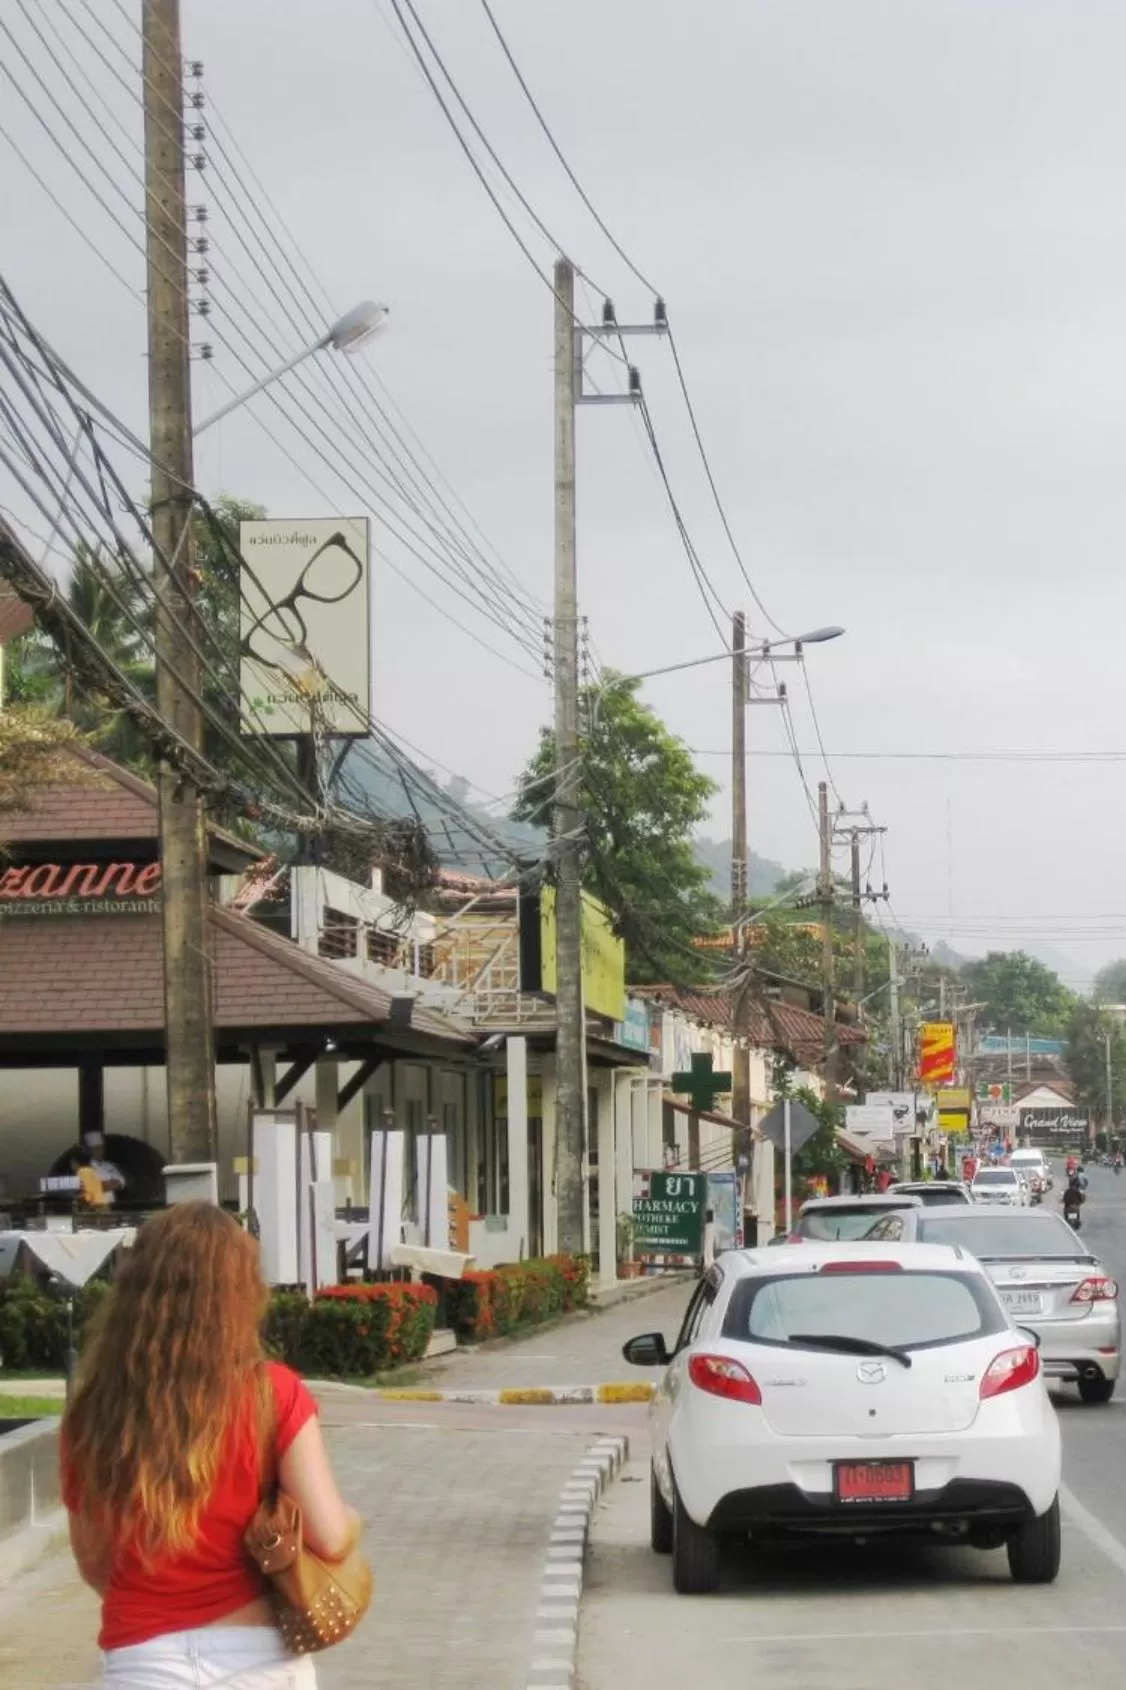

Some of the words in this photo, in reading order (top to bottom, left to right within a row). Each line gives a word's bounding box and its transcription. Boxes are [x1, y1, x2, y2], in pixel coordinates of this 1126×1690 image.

[1023, 1113, 1060, 1129] Grand
[665, 1176, 696, 1197] ยา
[634, 1200, 699, 1213] HARMACY
